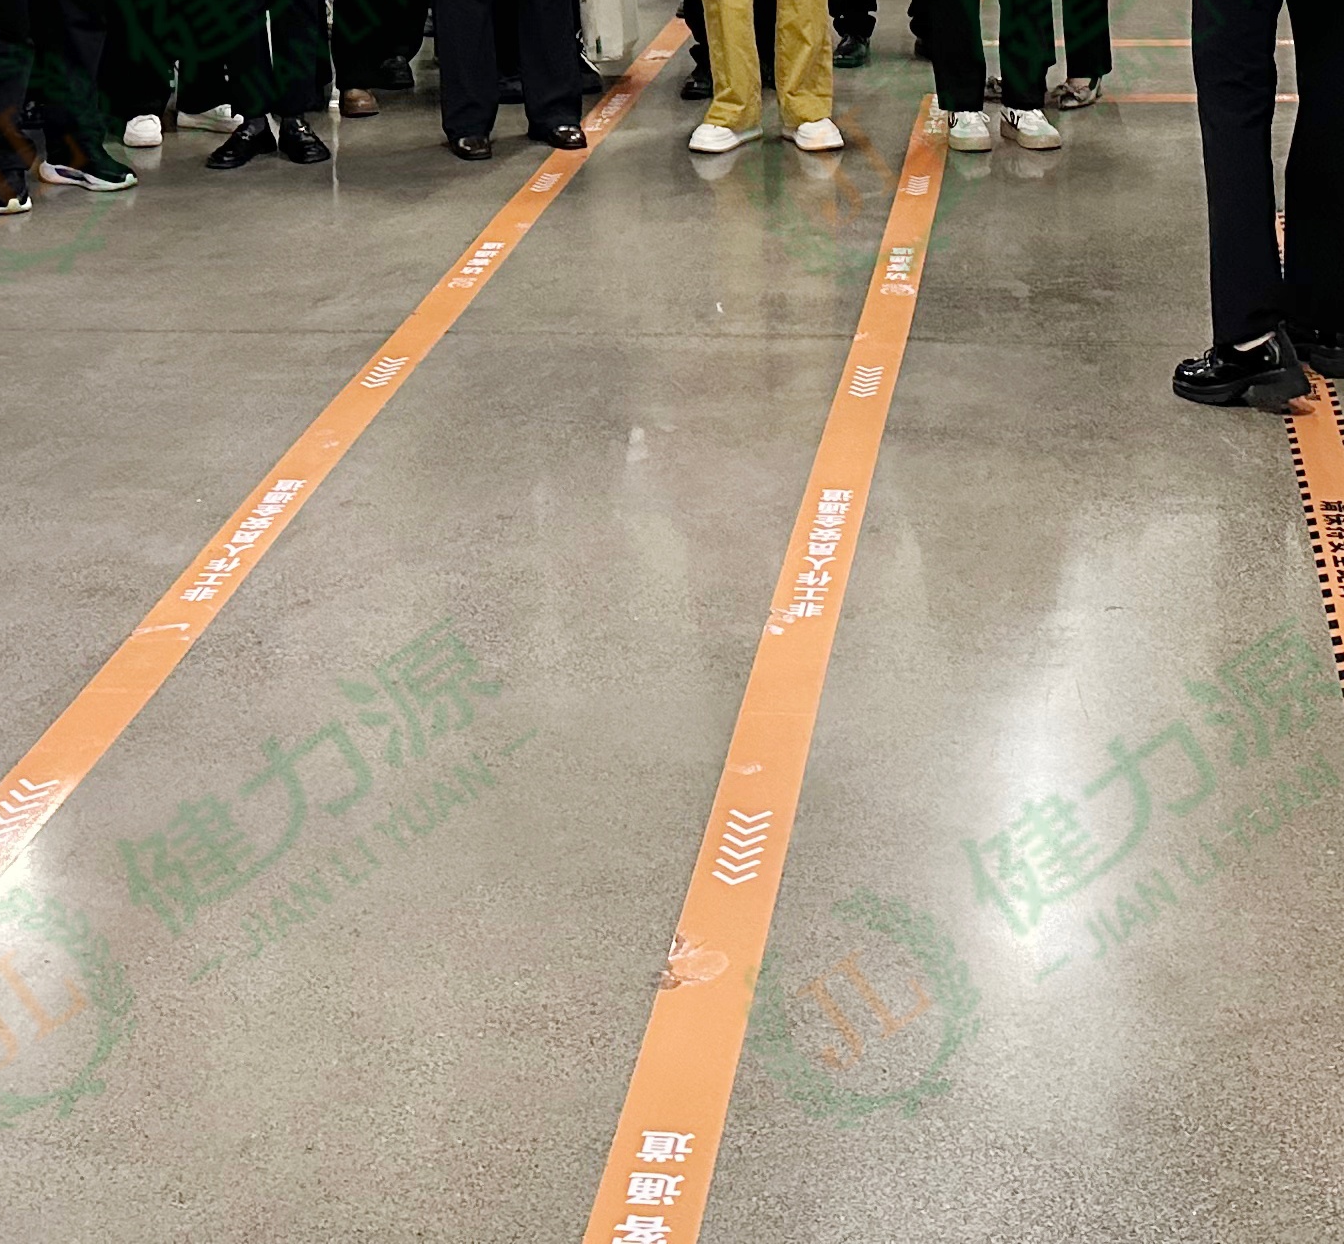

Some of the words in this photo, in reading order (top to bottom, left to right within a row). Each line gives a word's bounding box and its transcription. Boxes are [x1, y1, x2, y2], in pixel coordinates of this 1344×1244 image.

[180, 478, 309, 603] 非工作人员安全通道
[789, 487, 855, 619] 非工作人员安全通道
